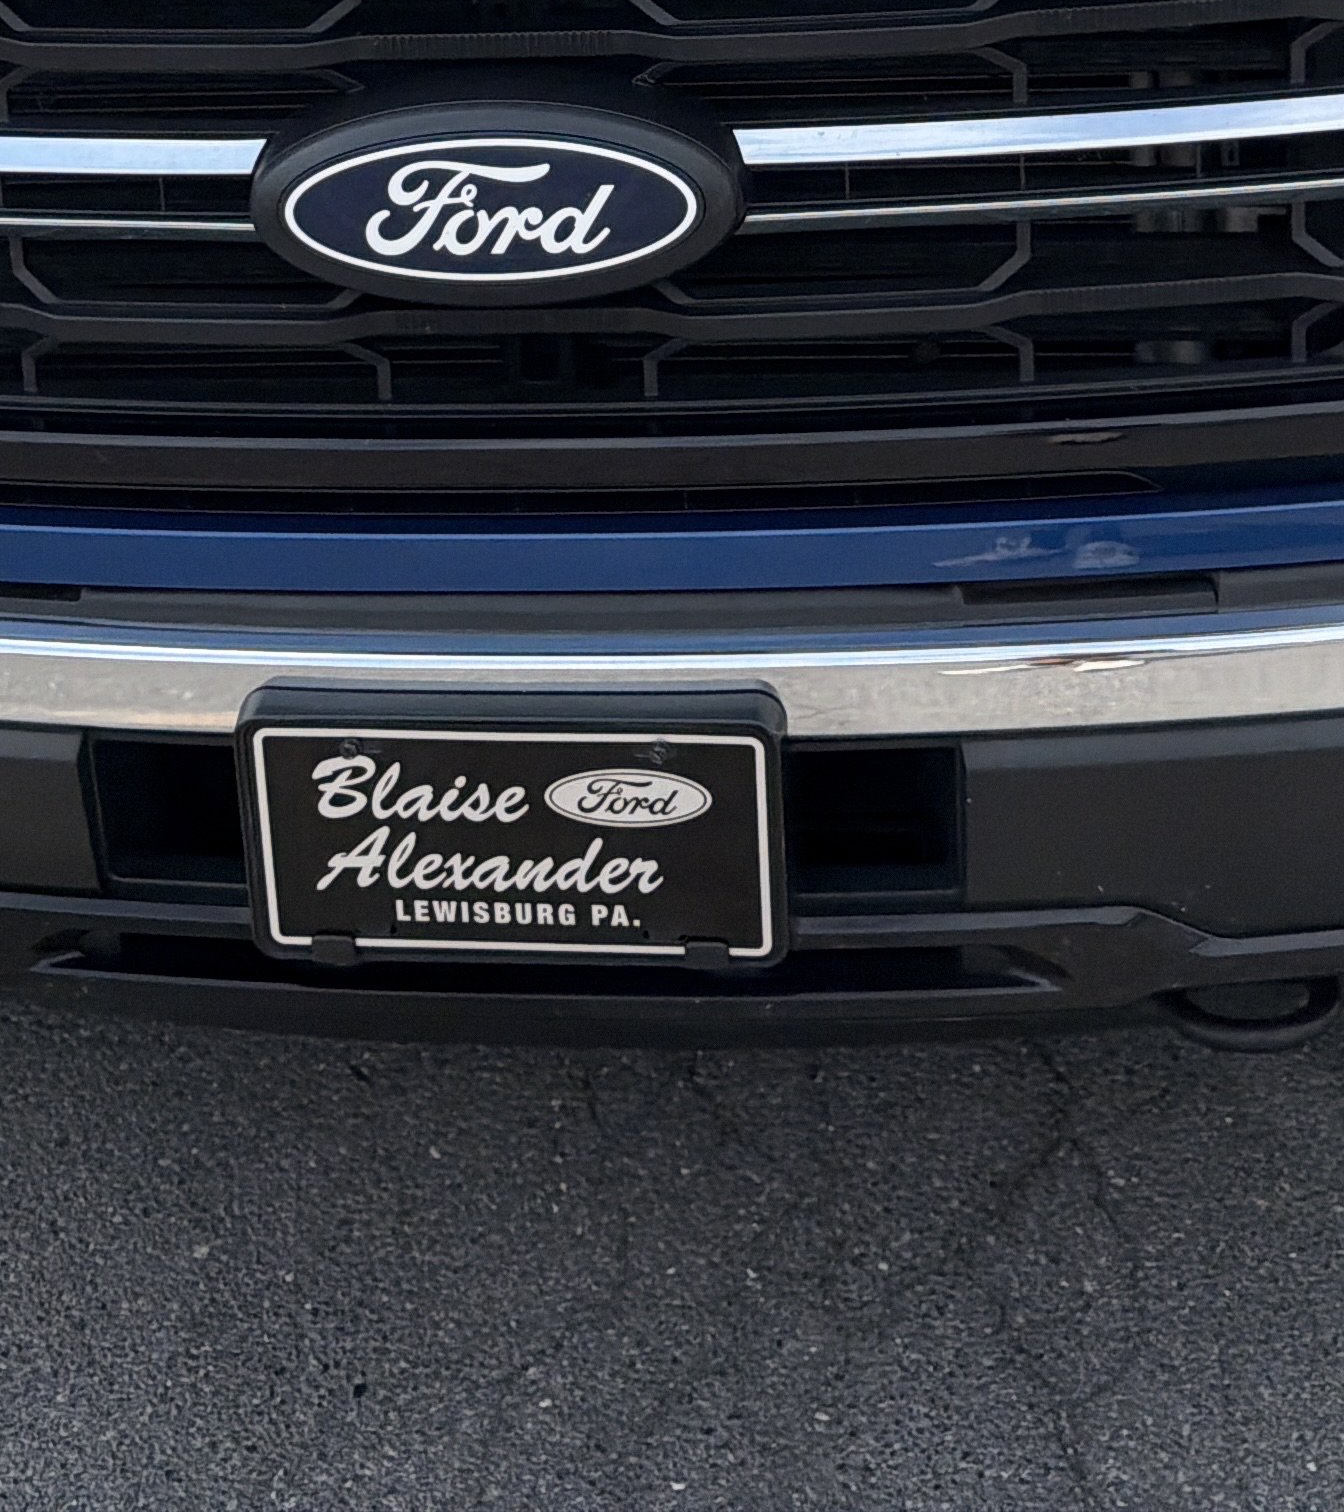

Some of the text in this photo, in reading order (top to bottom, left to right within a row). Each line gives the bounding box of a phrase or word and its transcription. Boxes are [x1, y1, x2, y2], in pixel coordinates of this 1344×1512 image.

[365, 160, 615, 256] Ford
[311, 754, 530, 823] Blaise
[576, 778, 679, 816] Ford
[316, 825, 664, 894] Alexander
[395, 899, 641, 927] LEWISBURG PA.
